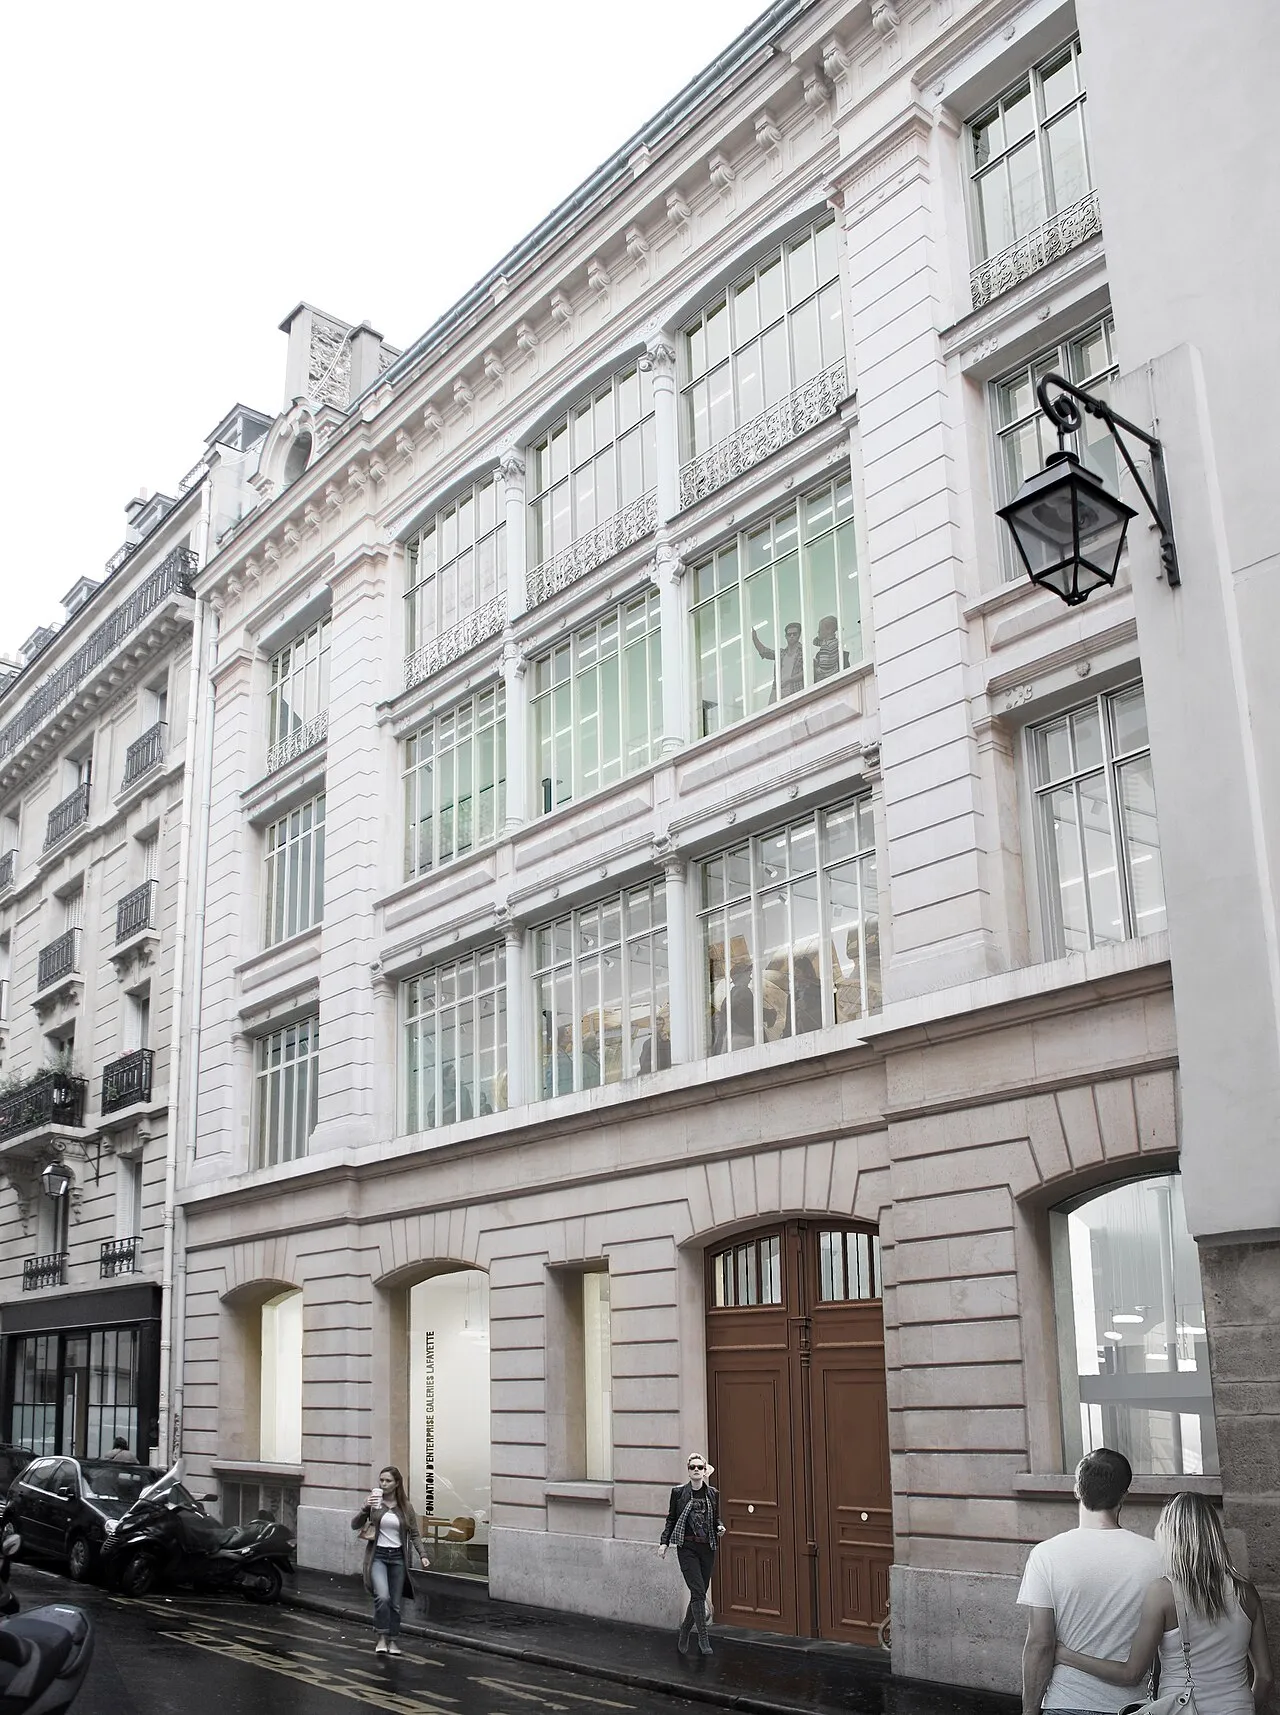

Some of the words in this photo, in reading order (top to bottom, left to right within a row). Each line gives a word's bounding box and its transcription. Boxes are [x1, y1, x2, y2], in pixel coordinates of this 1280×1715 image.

[425, 1331, 435, 1373] LAFAYETTE
[425, 1375, 435, 1413] GALERIES
[425, 1472, 435, 1516] FONDATION
